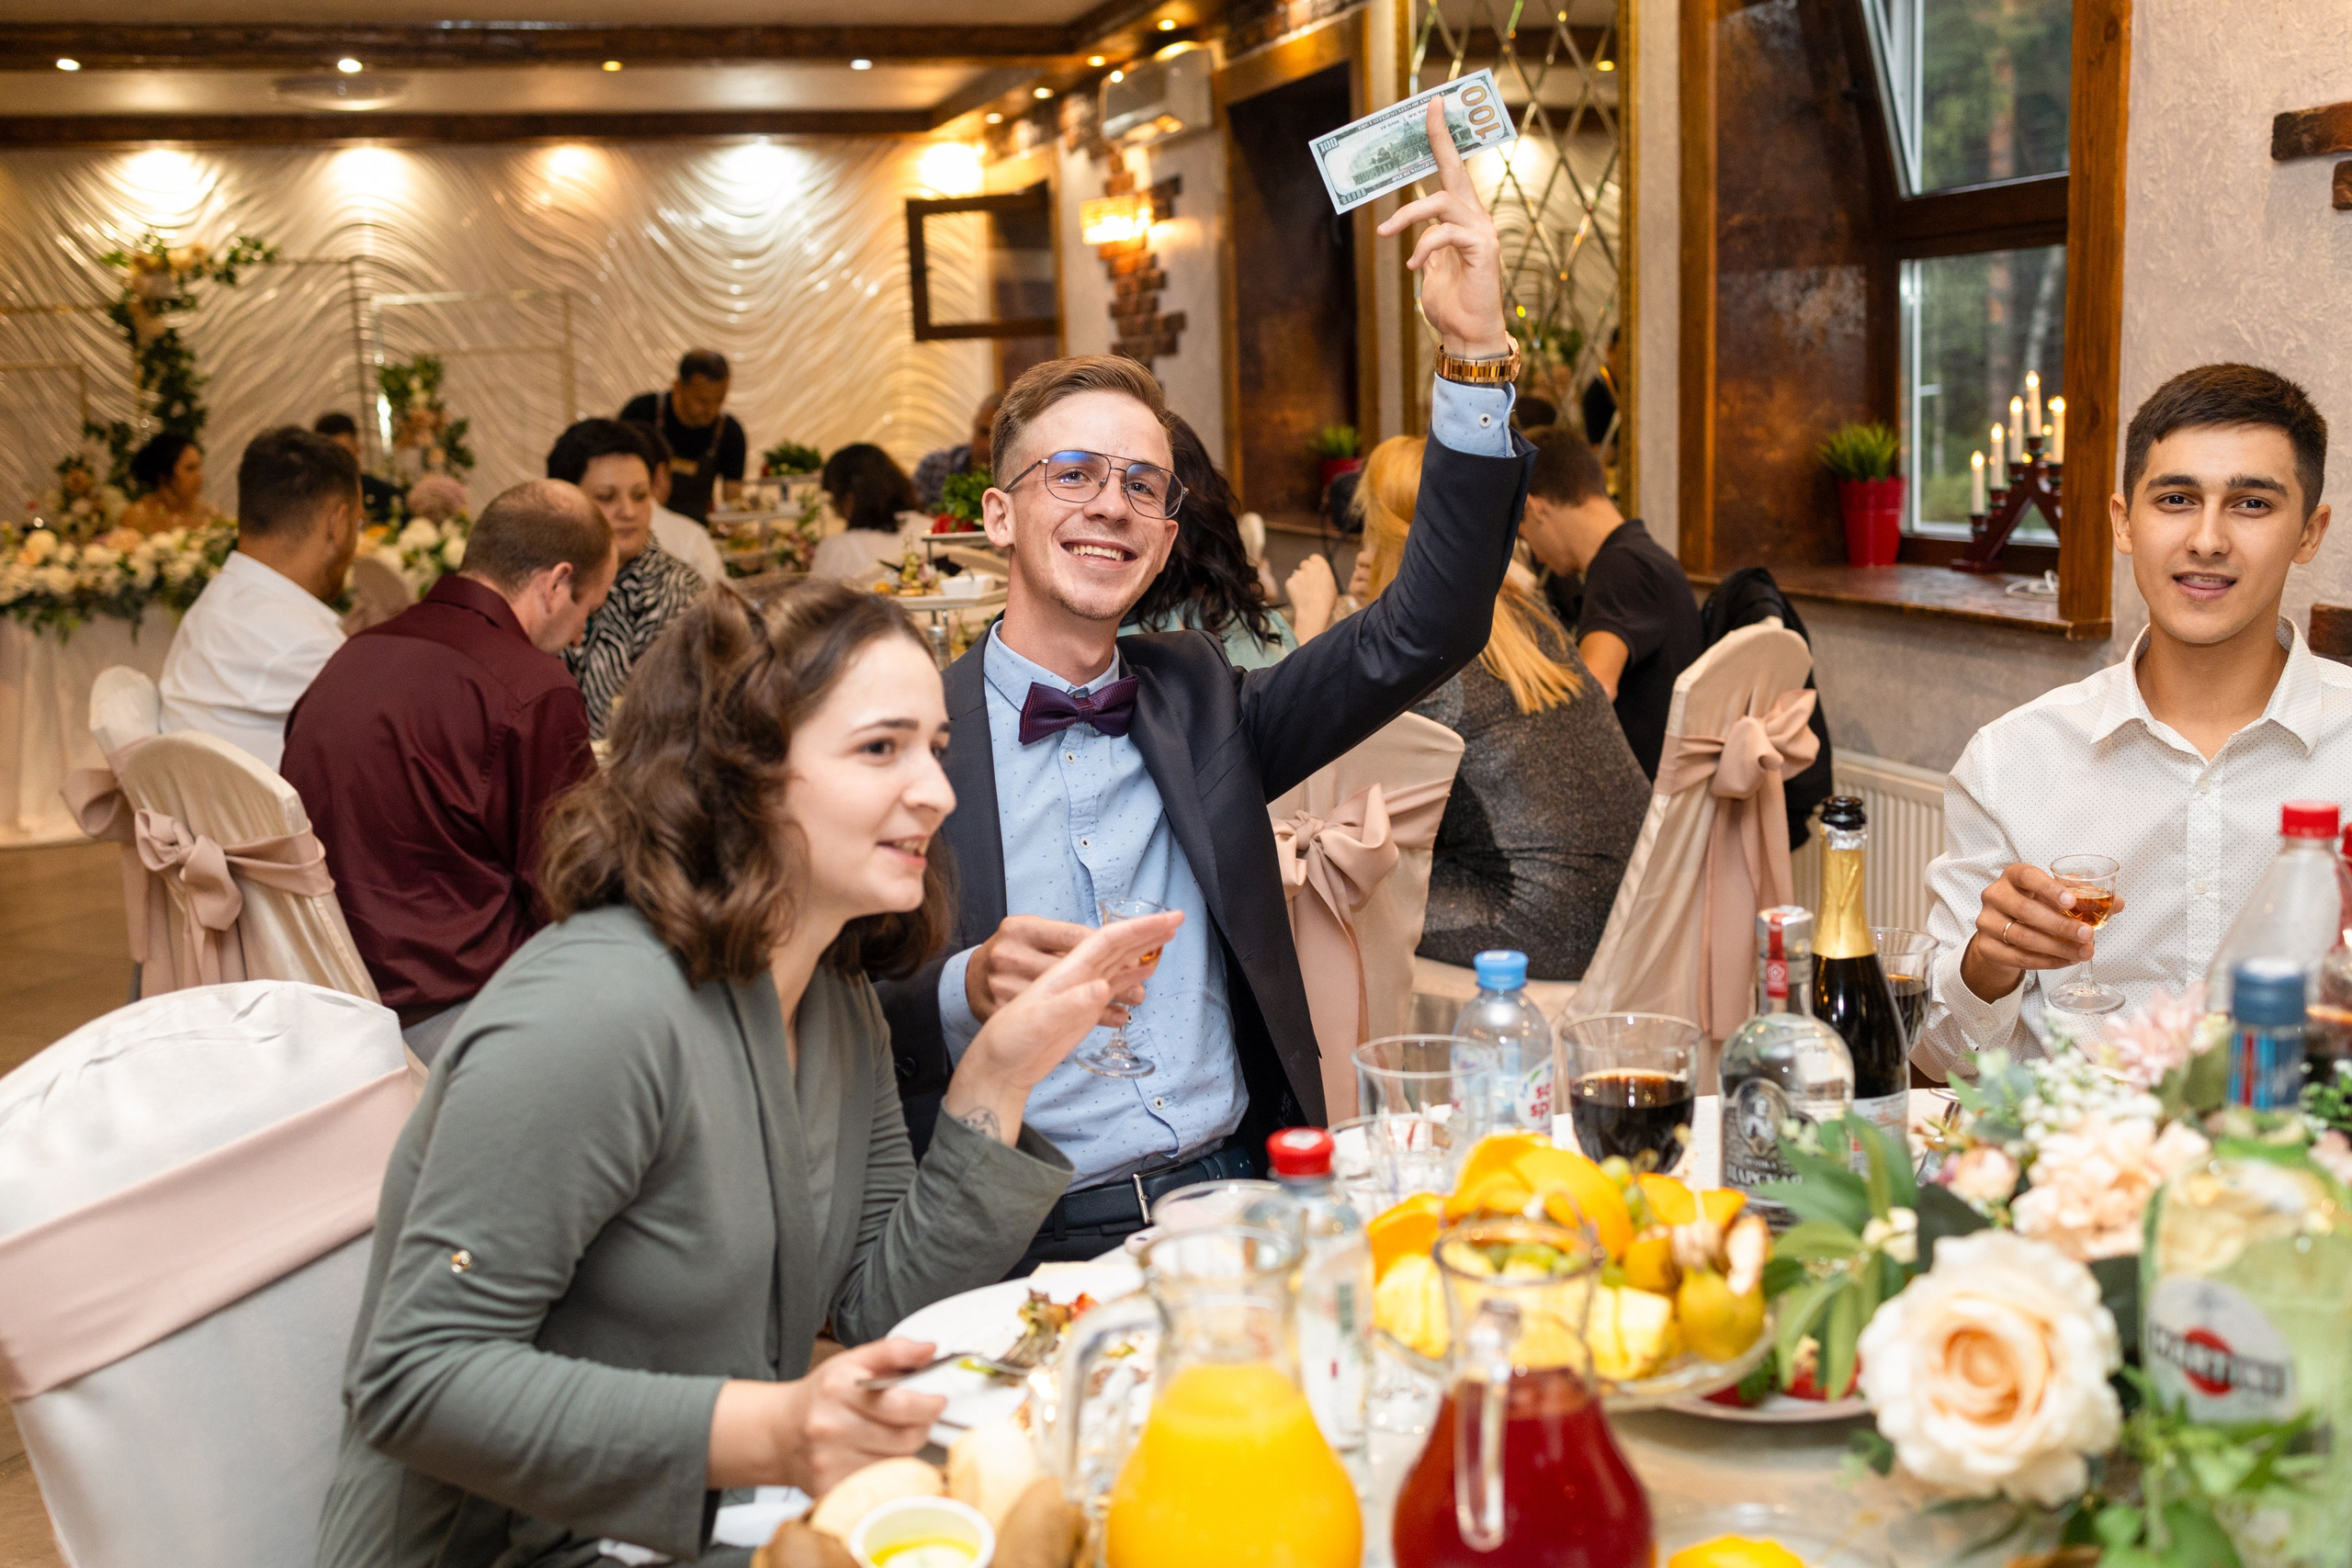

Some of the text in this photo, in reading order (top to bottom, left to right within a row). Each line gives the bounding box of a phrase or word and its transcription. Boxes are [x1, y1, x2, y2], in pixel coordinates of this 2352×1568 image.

[1358, 122, 1370, 130] THE
[1369, 112, 1390, 126] UNITED
[1390, 103, 1412, 117] STATES
[1461, 85, 1500, 140] 100
[1318, 137, 1340, 152] 100
[1392, 172, 1404, 182] ONE
[1403, 161, 1430, 176] HUNDRED
[1340, 187, 1367, 206] 100
